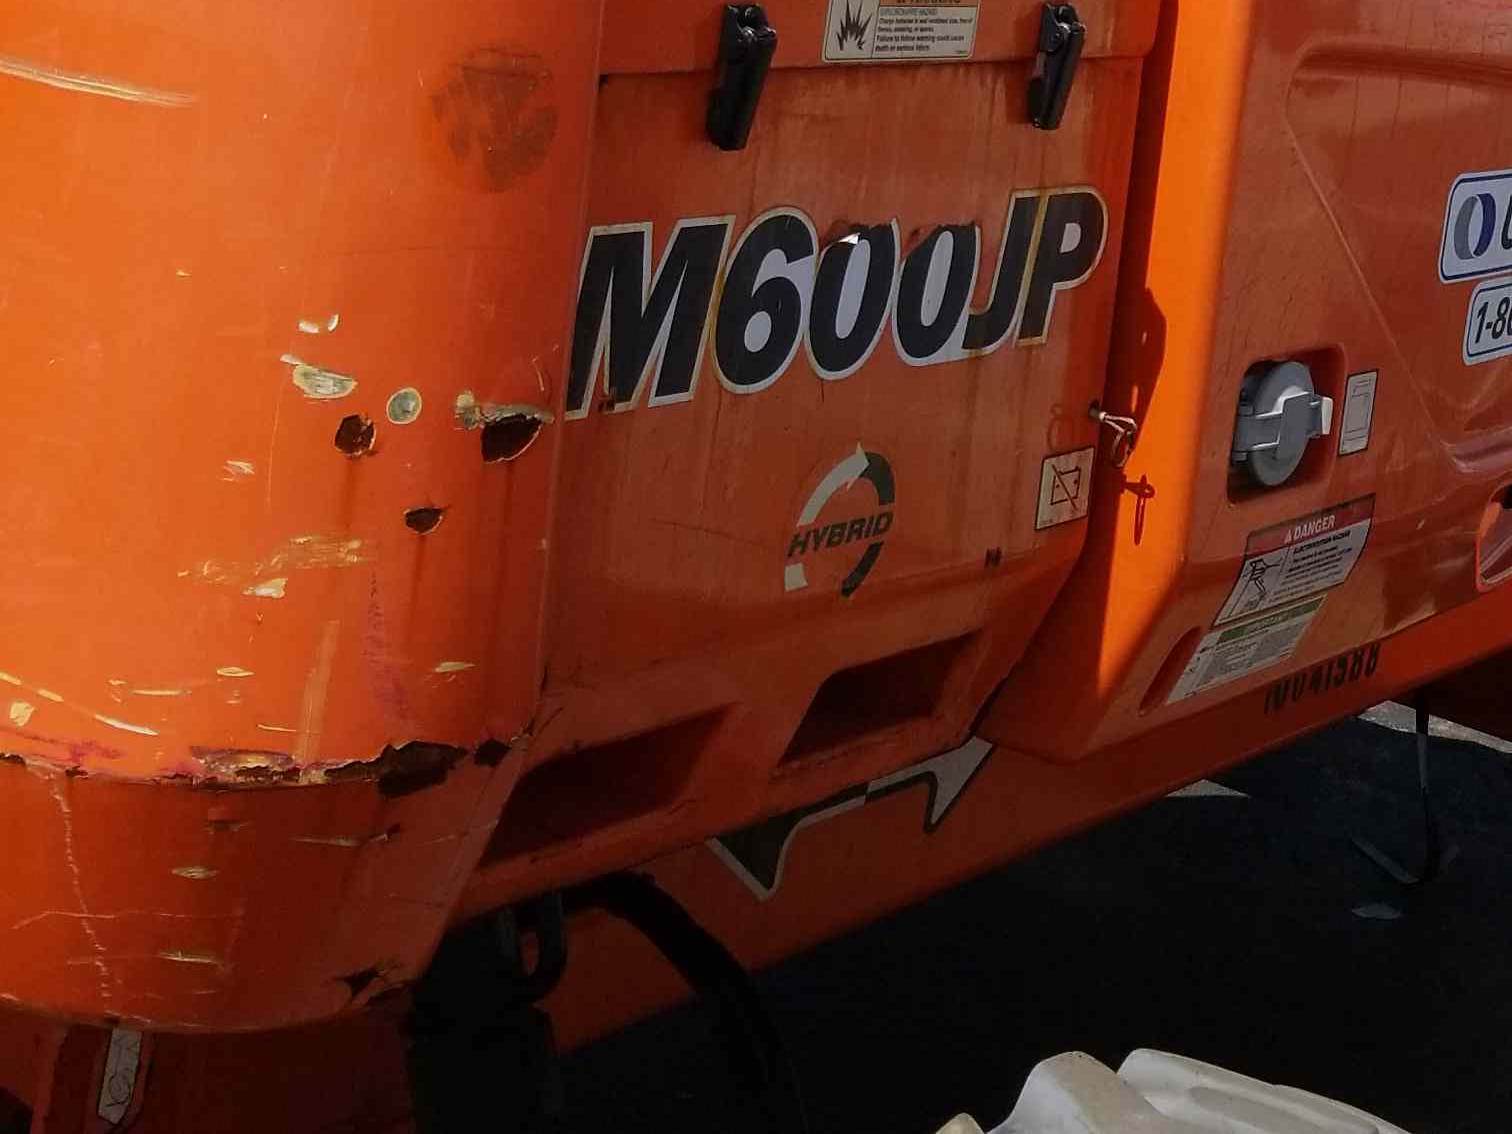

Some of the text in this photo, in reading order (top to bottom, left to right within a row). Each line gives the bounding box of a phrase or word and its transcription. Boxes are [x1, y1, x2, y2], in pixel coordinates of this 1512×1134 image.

[564, 185, 1109, 421] M600JP
[786, 511, 893, 558] HYBRID
[1293, 515, 1336, 541] DANGER
